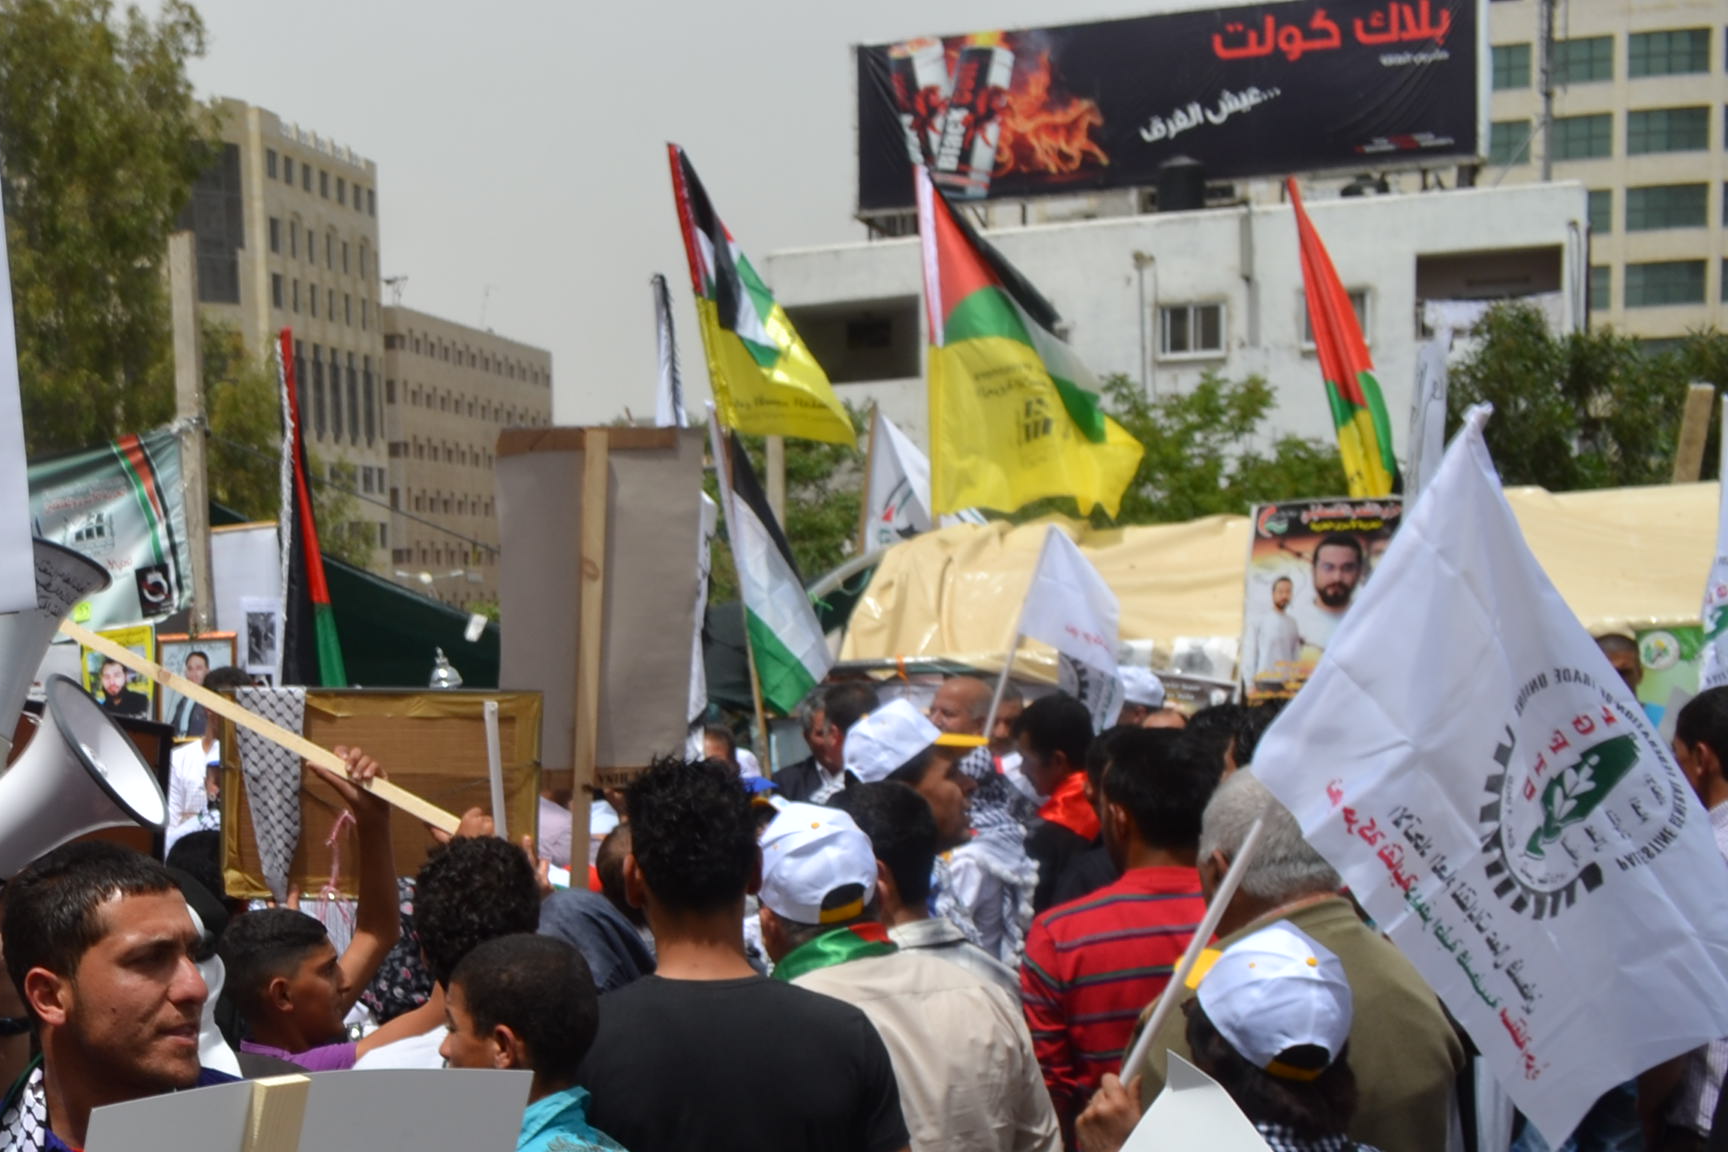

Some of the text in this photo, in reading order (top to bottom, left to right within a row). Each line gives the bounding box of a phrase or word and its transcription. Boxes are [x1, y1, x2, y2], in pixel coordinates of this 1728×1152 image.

[1212, 0, 1452, 62] بلاك كولت
[1139, 101, 1204, 143] الفرق
